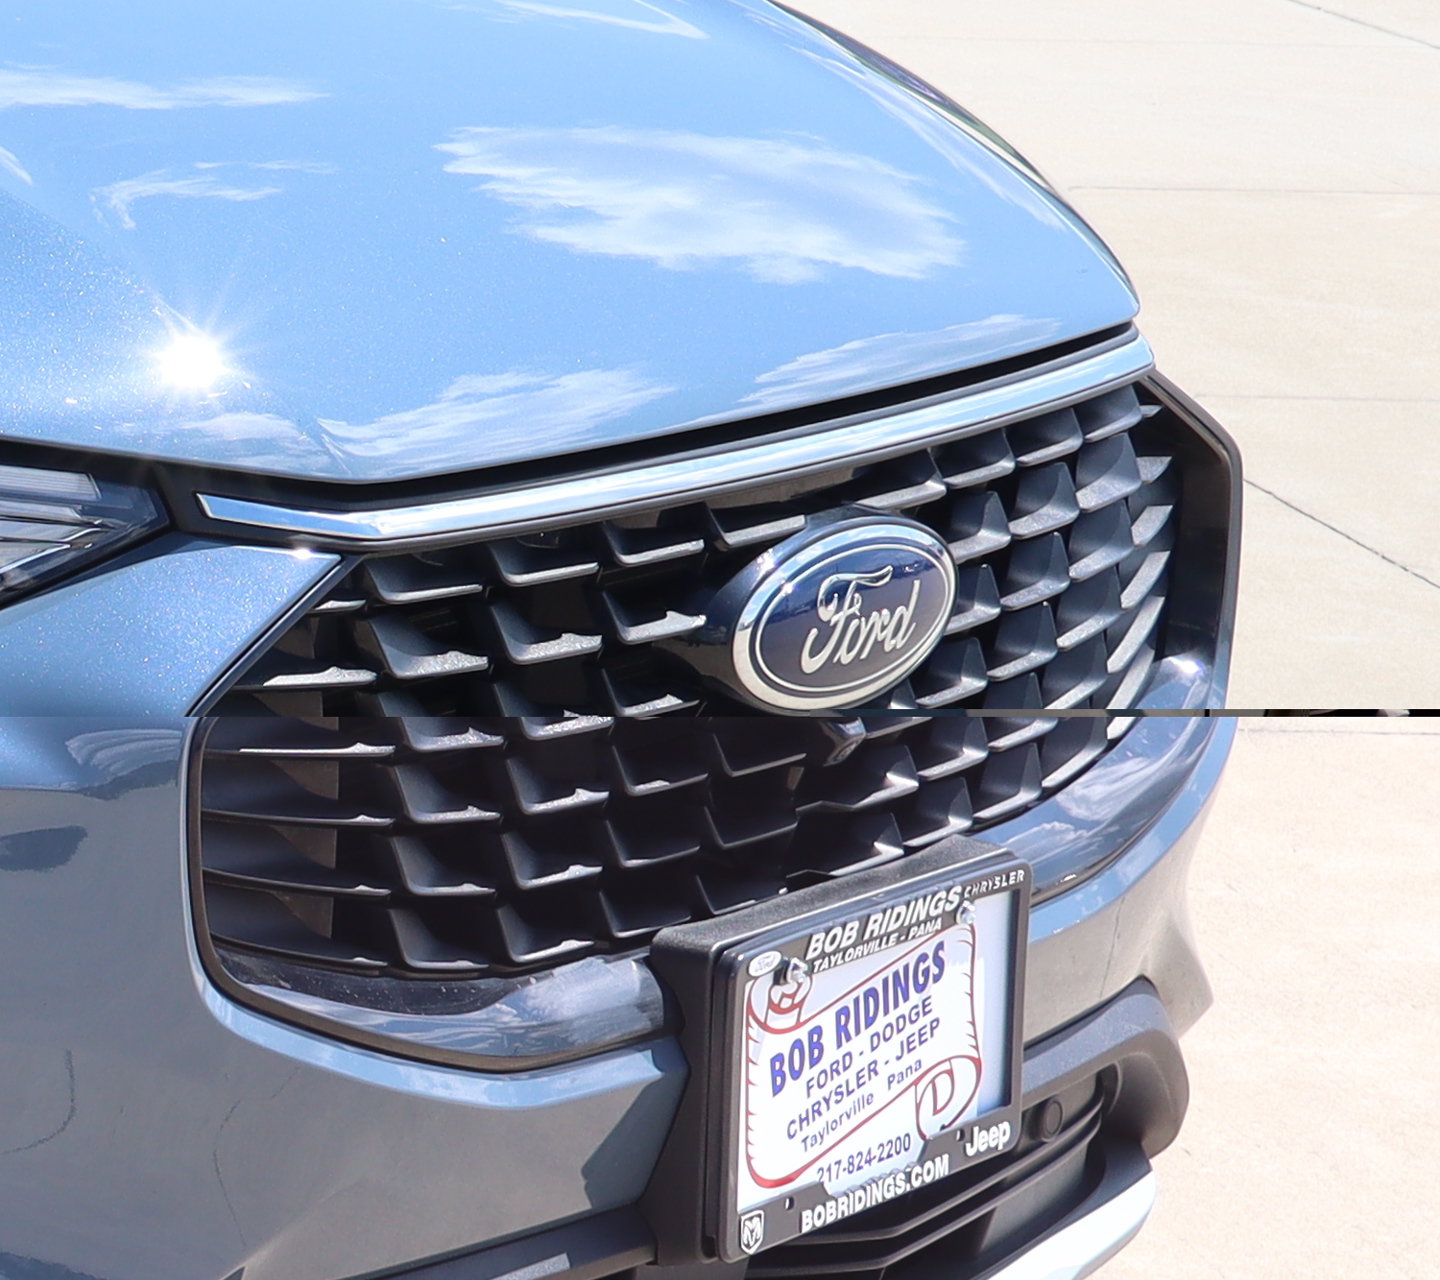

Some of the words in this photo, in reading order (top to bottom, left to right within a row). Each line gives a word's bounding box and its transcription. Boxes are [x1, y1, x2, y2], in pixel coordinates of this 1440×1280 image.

[800, 564, 921, 675] Ford
[805, 919, 860, 961] BOB
[863, 885, 962, 941] RIDINGS
[964, 869, 1025, 899] CHRYSLER
[813, 932, 898, 974] TAYLORVILLE
[908, 917, 943, 941] PANA
[770, 1025, 824, 1097] BOB
[835, 940, 945, 1050] RIDINGS
[806, 1051, 853, 1099] FORD
[870, 995, 932, 1052] DODGE
[786, 1060, 879, 1140] CHRYSLER
[895, 1017, 940, 1061] JEEP
[800, 1091, 874, 1152] Taylorville
[887, 1058, 922, 1090] Pana
[817, 1132, 912, 1183] 217-824-2200
[965, 1121, 1011, 1157] Jeep
[800, 1154, 950, 1233] BOBRIDINGS.COM
